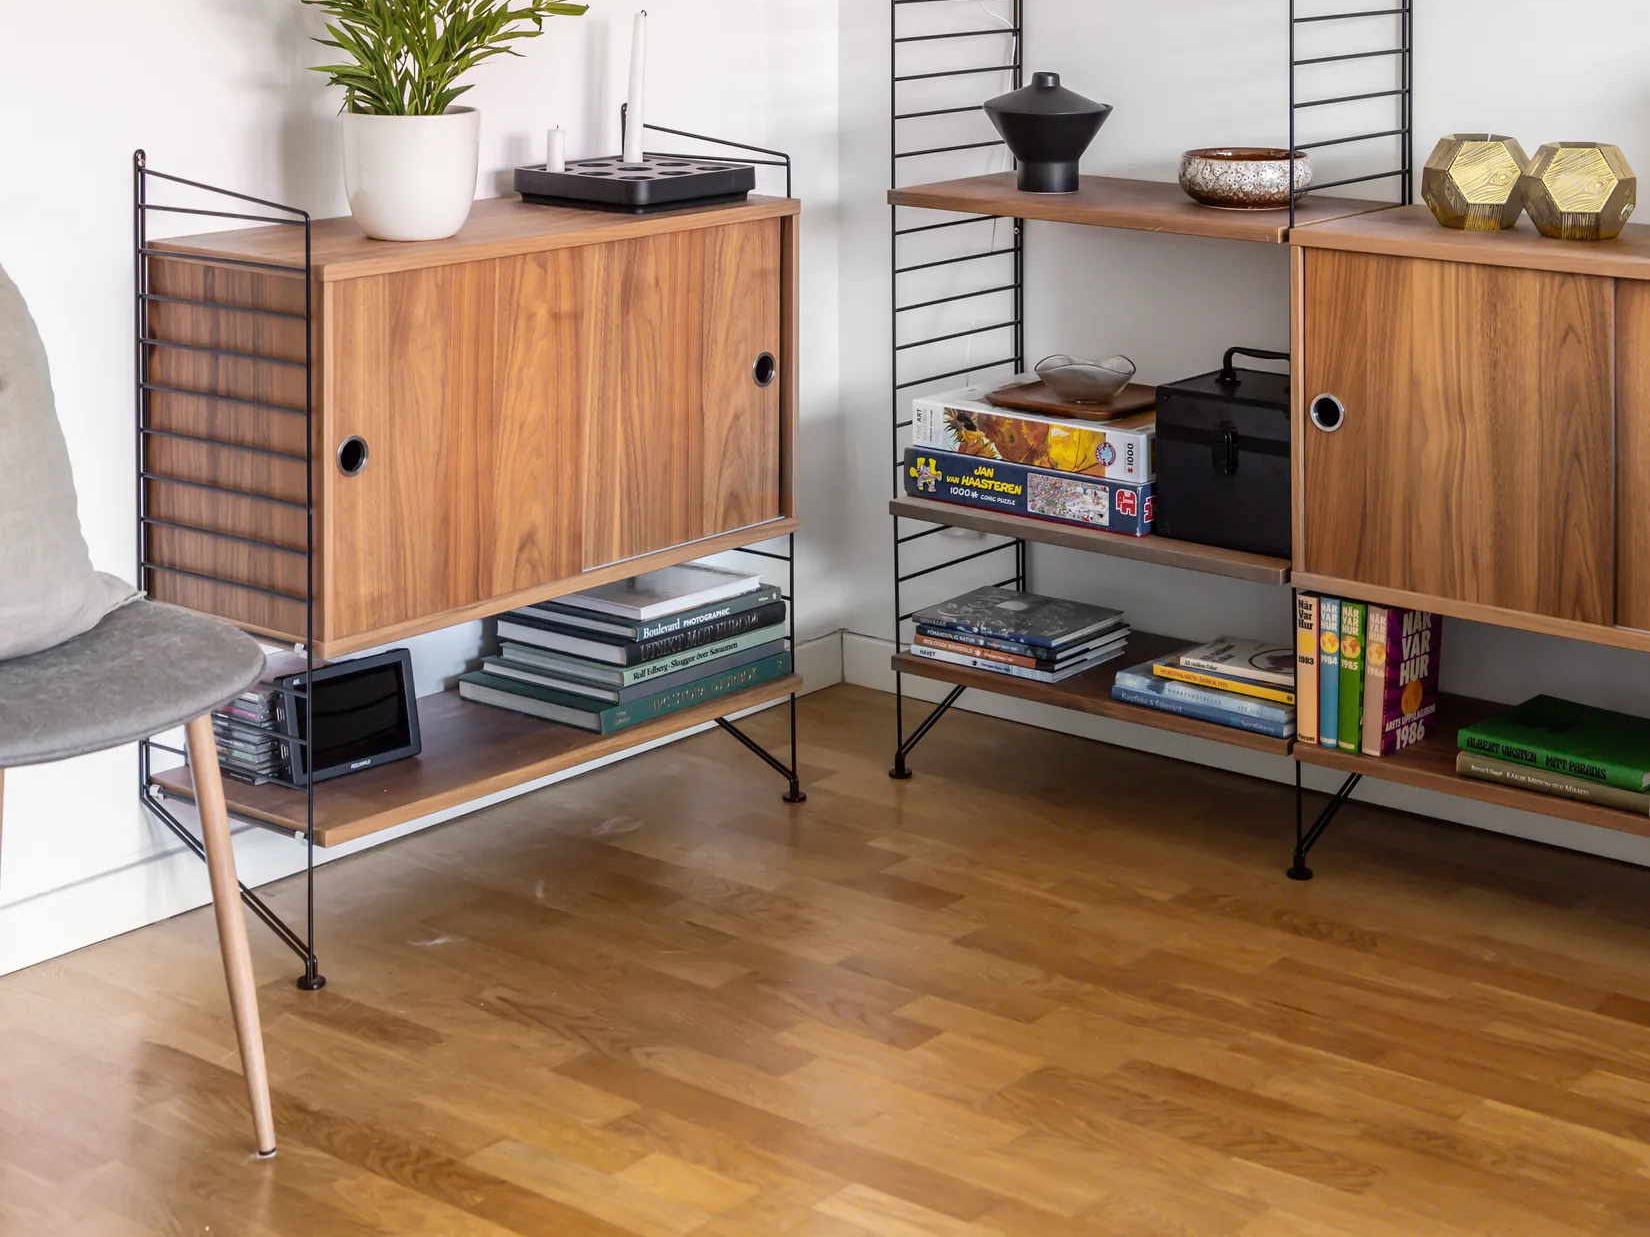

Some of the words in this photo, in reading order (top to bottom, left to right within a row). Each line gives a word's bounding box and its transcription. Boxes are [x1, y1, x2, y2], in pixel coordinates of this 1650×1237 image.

[974, 466, 994, 478] JAN
[946, 476, 960, 484] VAN
[962, 476, 1022, 494] HAASTEREN
[950, 486, 970, 496] 1000
[980, 494, 996, 502] COMIC
[997, 497, 1016, 505] PUZZLE
[1298, 600, 1312, 610] När
[1321, 603, 1337, 613] NÄR
[1298, 609, 1312, 620] Var
[1321, 612, 1337, 622] VAR
[1343, 606, 1359, 618] NÄR
[643, 618, 680, 638] Boulevard
[683, 608, 730, 626] PHOTOGRAPHIC
[1298, 619, 1313, 630] Hur
[1321, 620, 1337, 631] HUR
[1343, 616, 1359, 627] VAR
[1370, 613, 1386, 626] NÄR
[1342, 624, 1359, 636] HUR
[1370, 623, 1386, 635] VAR
[640, 634, 685, 660] UTSIKT
[686, 626, 714, 647] MOT
[1369, 631, 1385, 643] HUR
[924, 639, 947, 648] BIOLOGISK
[1402, 630, 1431, 662] VAR
[633, 669, 646, 680] Rolf
[648, 664, 668, 676] Edberg
[671, 655, 695, 668] Skuggor
[696, 651, 709, 660] över
[710, 642, 737, 656] Savannen
[1299, 655, 1314, 665] 1983
[1321, 655, 1338, 665] 1984
[1342, 660, 1358, 670] 1985
[1368, 666, 1384, 678] 1986
[1399, 654, 1429, 686] HUR
[1121, 692, 1149, 705] Kustfiske
[1386, 717, 1401, 732] ÅRETS
[1396, 719, 1425, 751] 1986
[1467, 737, 1500, 753] ALBERT
[1502, 745, 1537, 763] VIKSTEN
[1546, 756, 1568, 770] MITT
[1568, 761, 1606, 780] PARADIS
